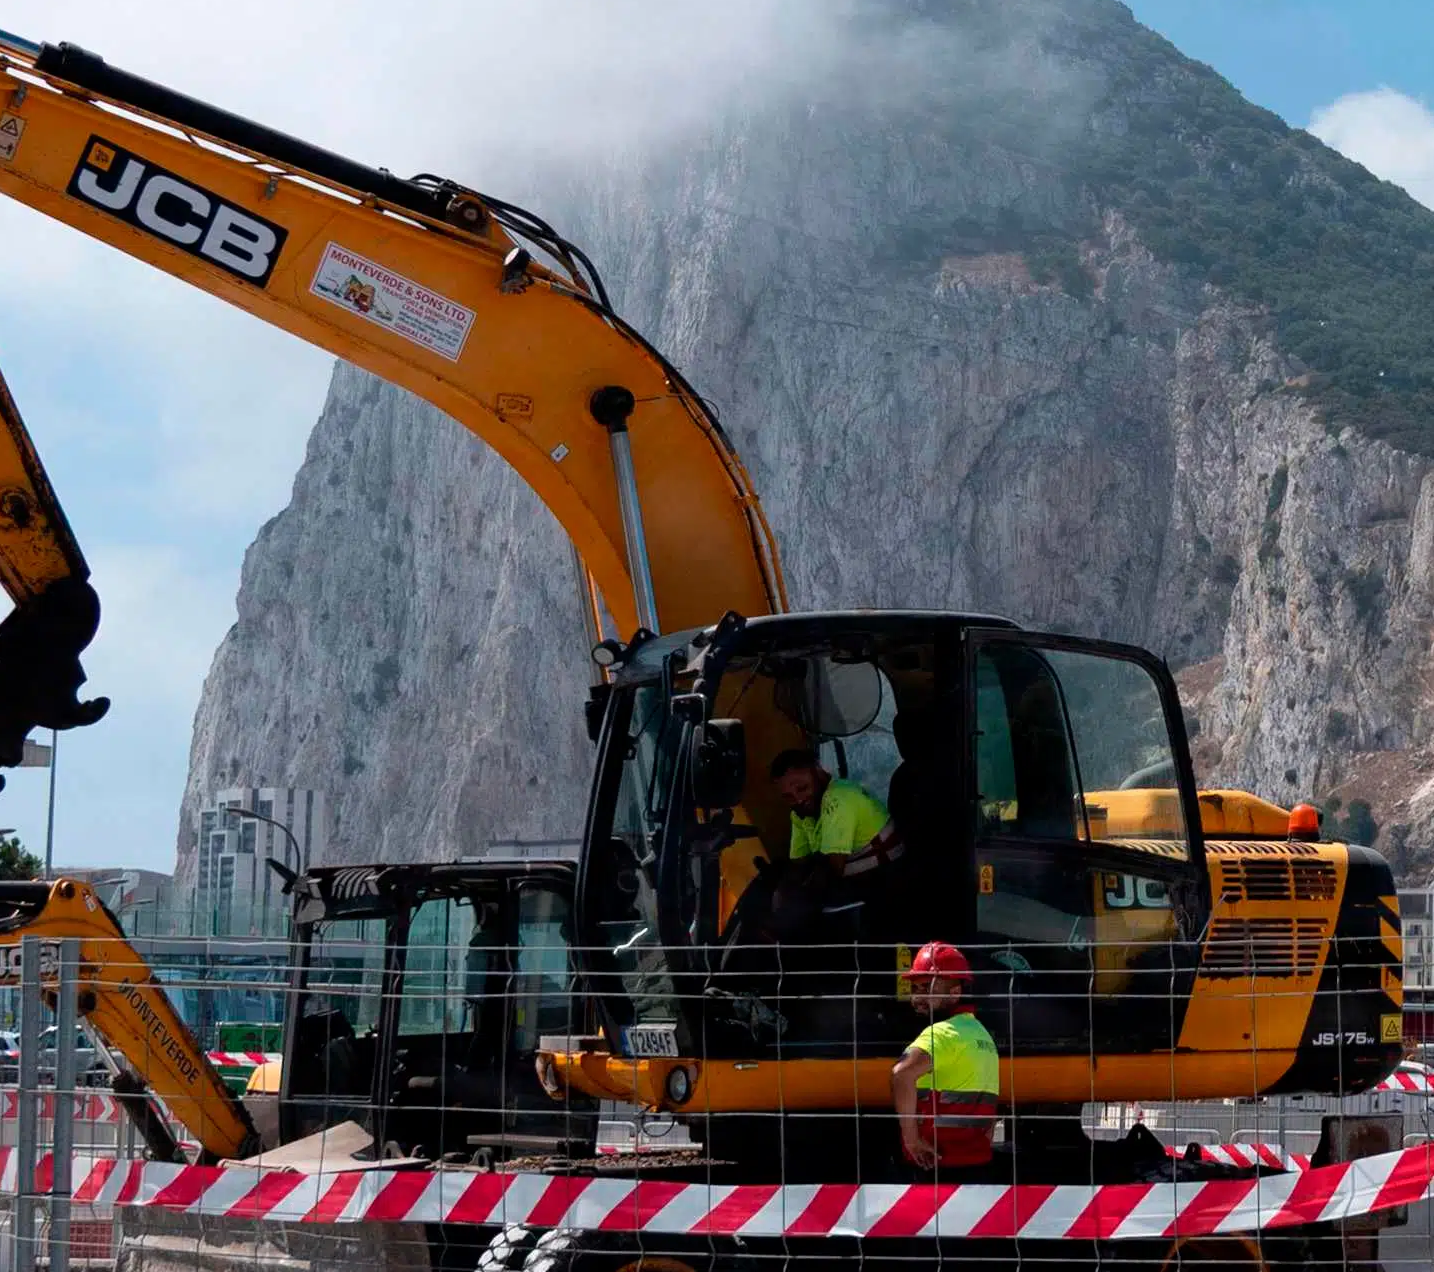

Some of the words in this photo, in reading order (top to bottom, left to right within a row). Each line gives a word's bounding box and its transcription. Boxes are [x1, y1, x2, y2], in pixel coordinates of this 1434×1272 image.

[77, 158, 277, 278] JCB
[329, 249, 405, 292] MONTEVERDE
[404, 286, 414, 296] &
[414, 290, 445, 311] SONS
[444, 304, 467, 325] LTD.
[1106, 873, 1175, 907] JC
[118, 977, 200, 1085] MONTEVERDE
